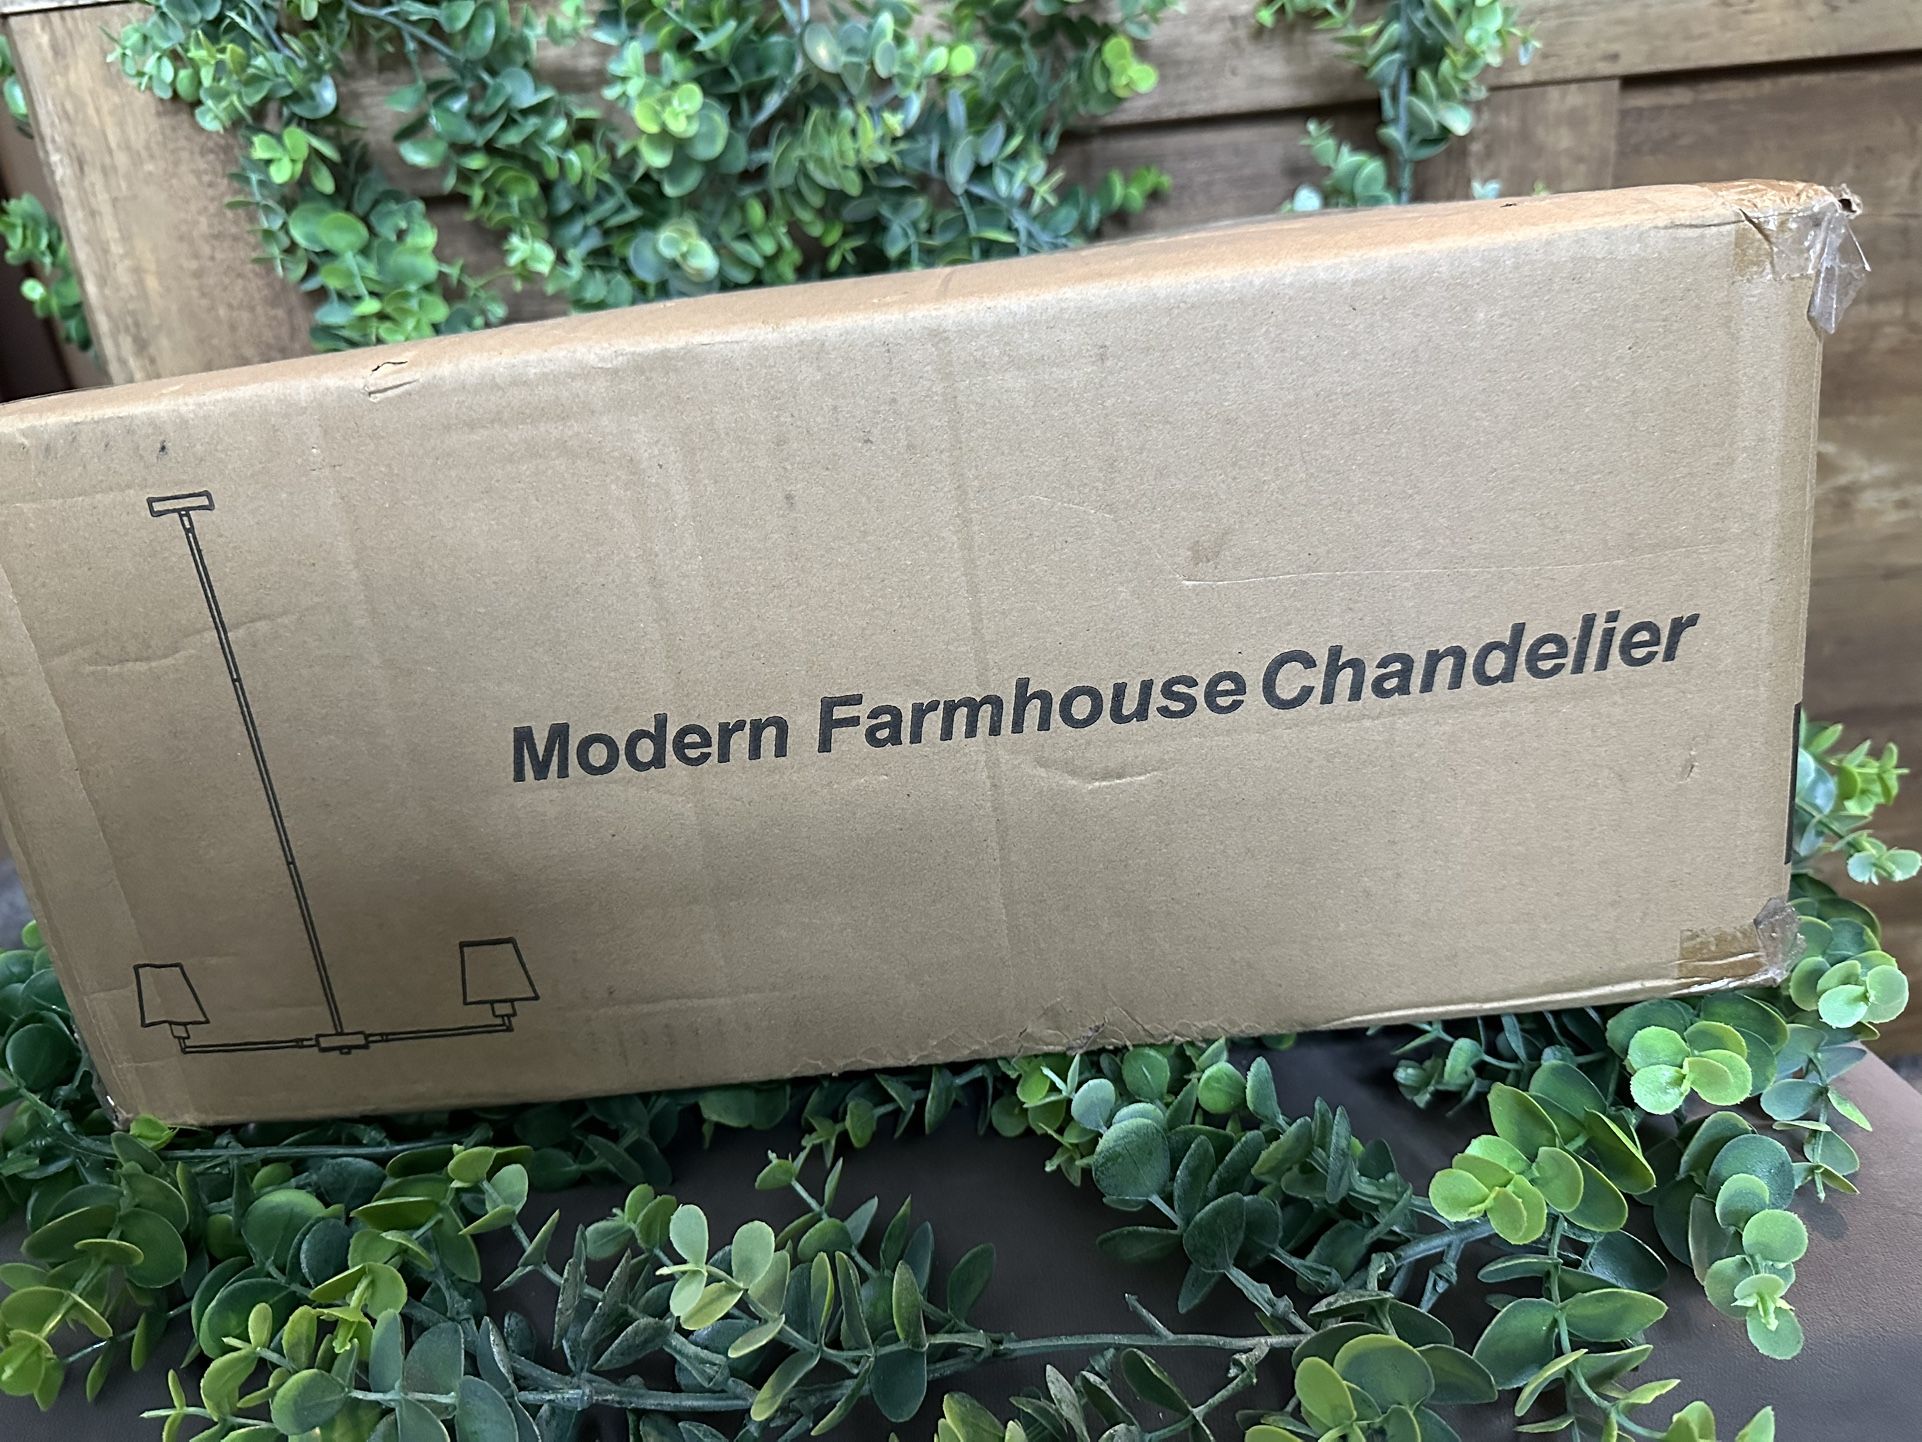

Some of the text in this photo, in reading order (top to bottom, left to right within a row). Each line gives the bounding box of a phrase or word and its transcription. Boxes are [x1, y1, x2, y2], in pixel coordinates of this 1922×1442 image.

[512, 609, 1701, 783] Modern Farmhouse Chandelier
